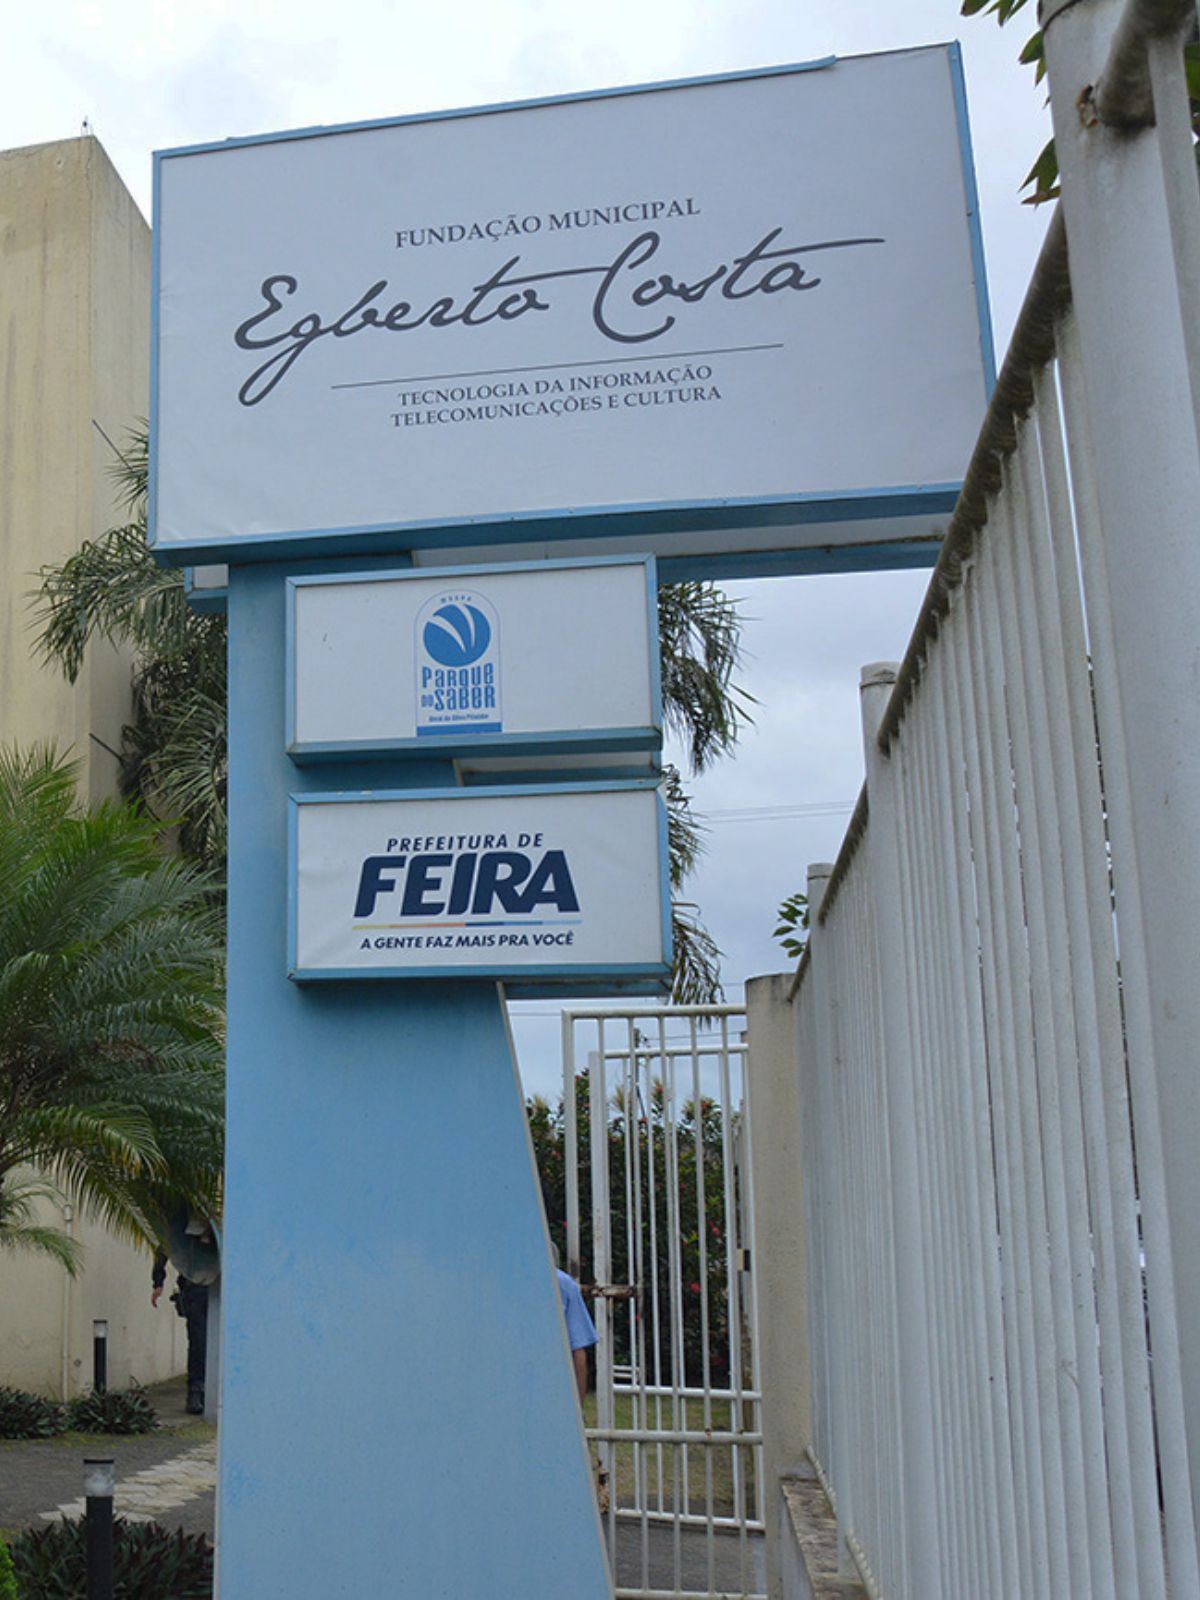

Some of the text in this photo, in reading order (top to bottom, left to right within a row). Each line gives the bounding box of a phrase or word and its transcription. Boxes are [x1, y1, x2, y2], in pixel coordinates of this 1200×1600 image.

[395, 197, 701, 248] FUNDAÇÃO MUNICIPAL
[234, 227, 885, 407] Egberto Costa
[390, 385, 722, 428] TELECOMUNICAÇÕES E CULTURA
[398, 363, 713, 407] TECNOLOGIA DA INFORMAÇÃO
[387, 832, 544, 852] PREFEITURA DE
[353, 850, 580, 918] FEIRA
[360, 929, 574, 949] A GENTE FAZ MAIS PRA VOCÊ
